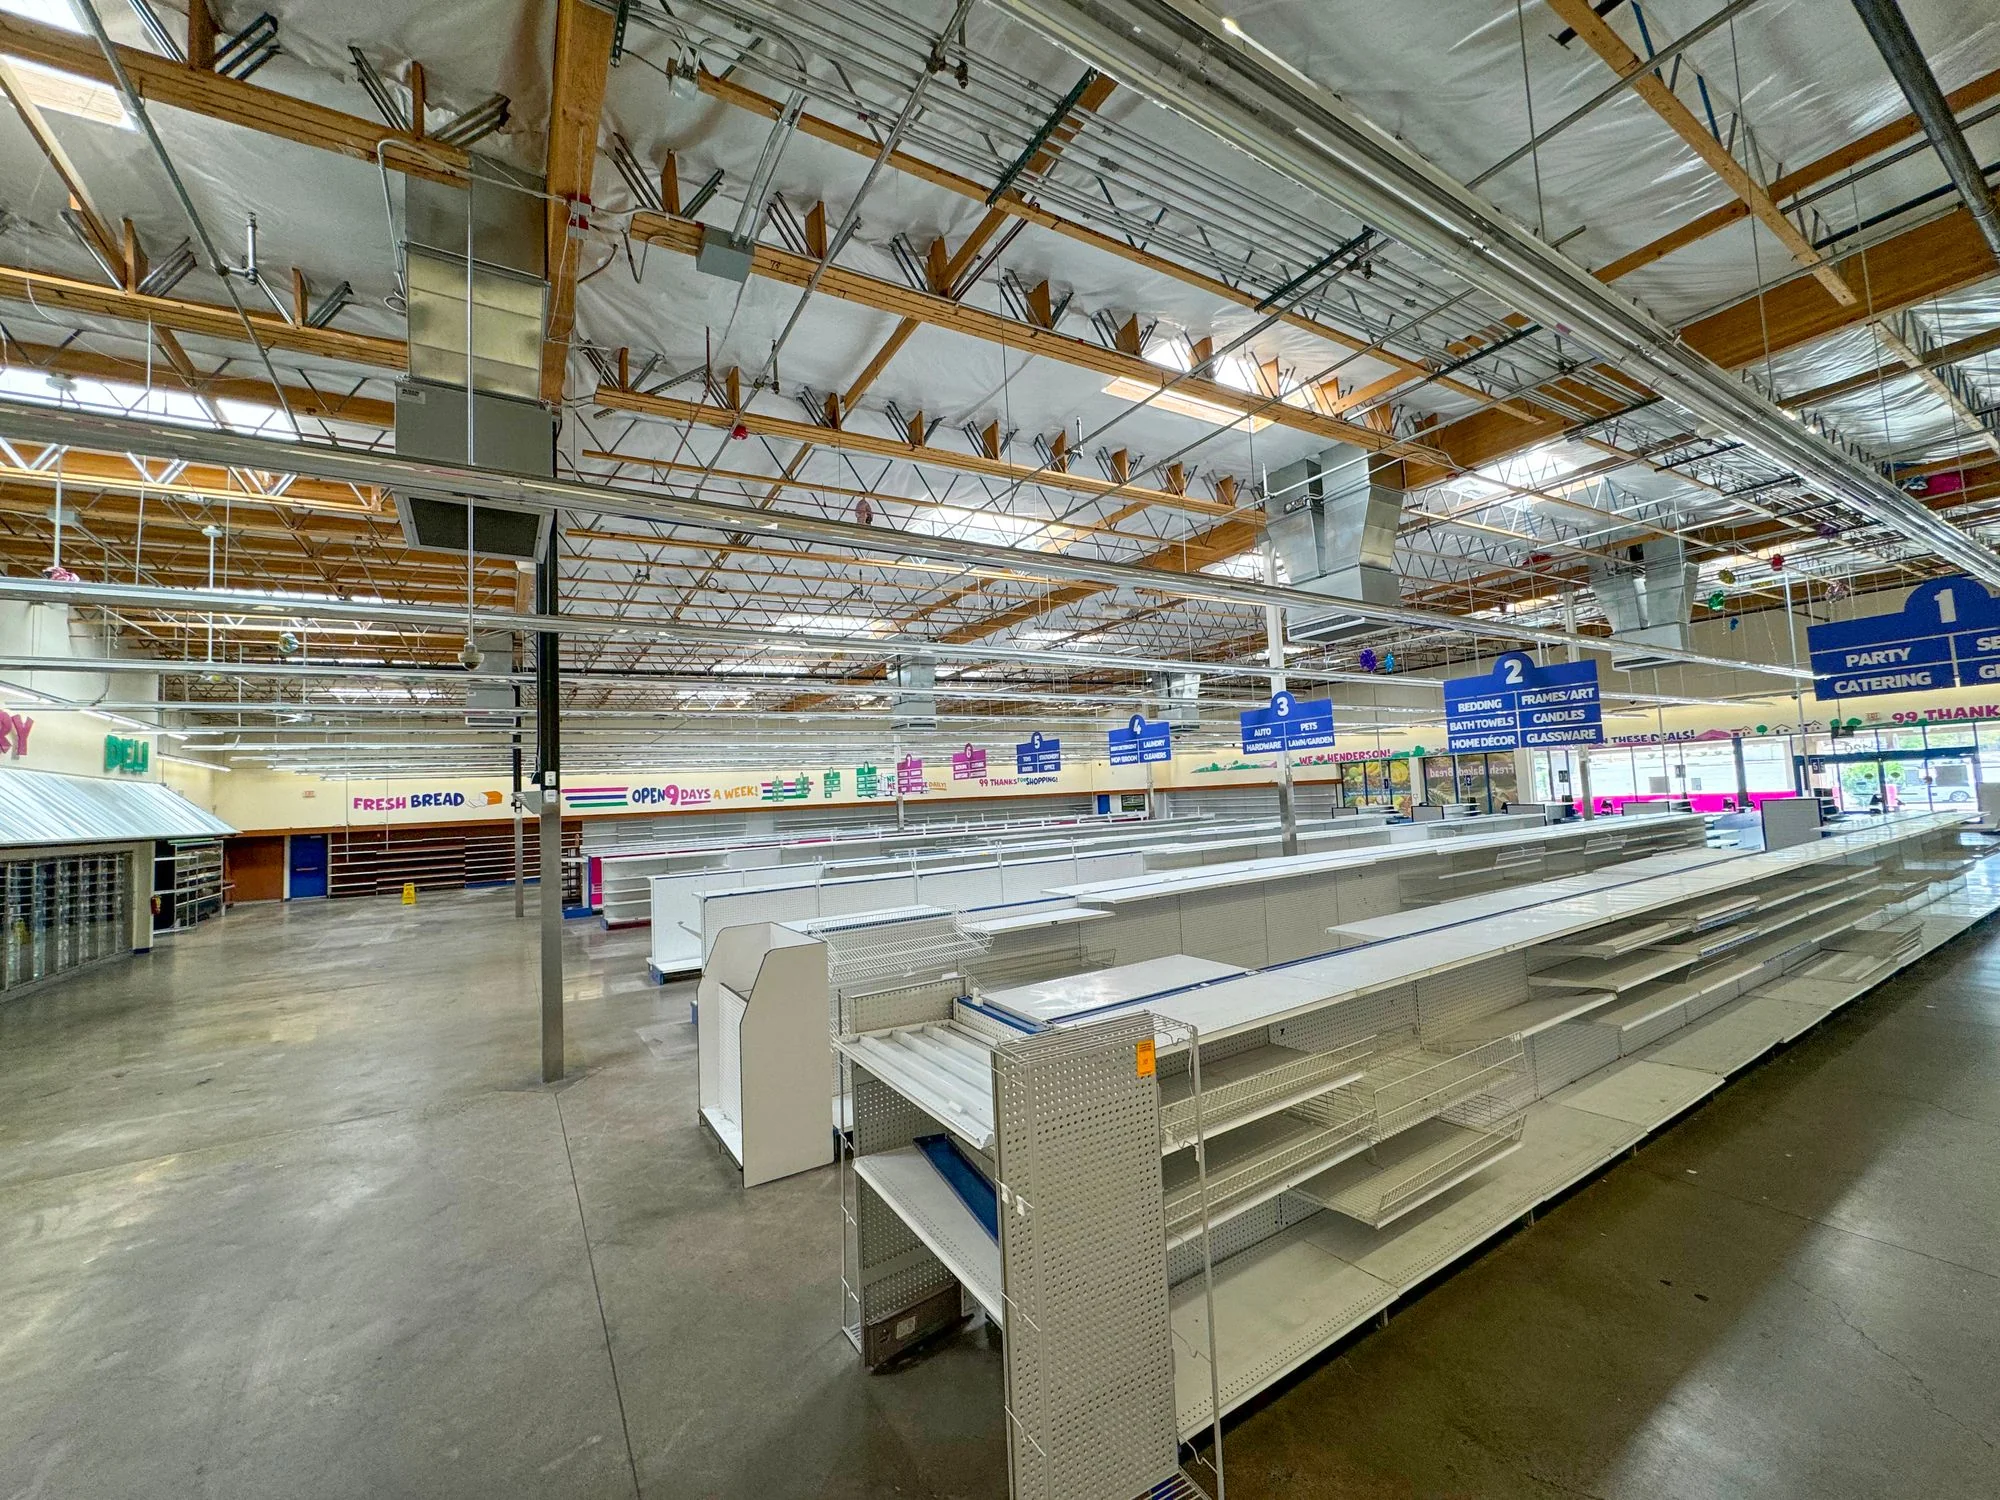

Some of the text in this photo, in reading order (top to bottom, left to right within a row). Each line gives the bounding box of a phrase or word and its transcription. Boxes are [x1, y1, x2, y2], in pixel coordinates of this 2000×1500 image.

[1934, 589, 1957, 624] 1
[1846, 647, 1912, 668] PARTY
[1504, 659, 1524, 685] 2
[1834, 671, 1932, 694] CATERING
[1521, 687, 1596, 706] FRAMES/ART
[1277, 696, 1289, 717] 3
[1457, 698, 1503, 713] BEDDING
[1450, 716, 1515, 732] BATH TOWELS
[1532, 709, 1586, 724] CANDLES
[1892, 711, 1918, 725] 99
[1133, 719, 1142, 735] 4
[1254, 729, 1272, 738] AUTO
[1300, 722, 1318, 732] PETS
[1034, 735, 1040, 749] 5
[1288, 735, 1333, 748] LAWN/GARDEN
[1451, 734, 1516, 750] HOME DÉCOR
[1526, 728, 1597, 744] GLASSWARE
[1613, 734, 1648, 744] THESE
[1651, 729, 1696, 743] DEALS!
[105, 734, 149, 773] DELI
[966, 746, 972, 759] 6
[1246, 740, 1282, 751] HARDWARE
[1299, 748, 1391, 765] WE HENDERSON!
[979, 779, 988, 787] 99
[990, 778, 1018, 787] THANKS
[1026, 776, 1058, 786] SHOPPING!
[353, 792, 465, 811] FRESH BREAD
[632, 787, 665, 804] OPEN
[664, 784, 679, 806] 9
[680, 788, 711, 801] DAYS
[713, 789, 721, 800] A
[724, 785, 759, 800] WEEK!
